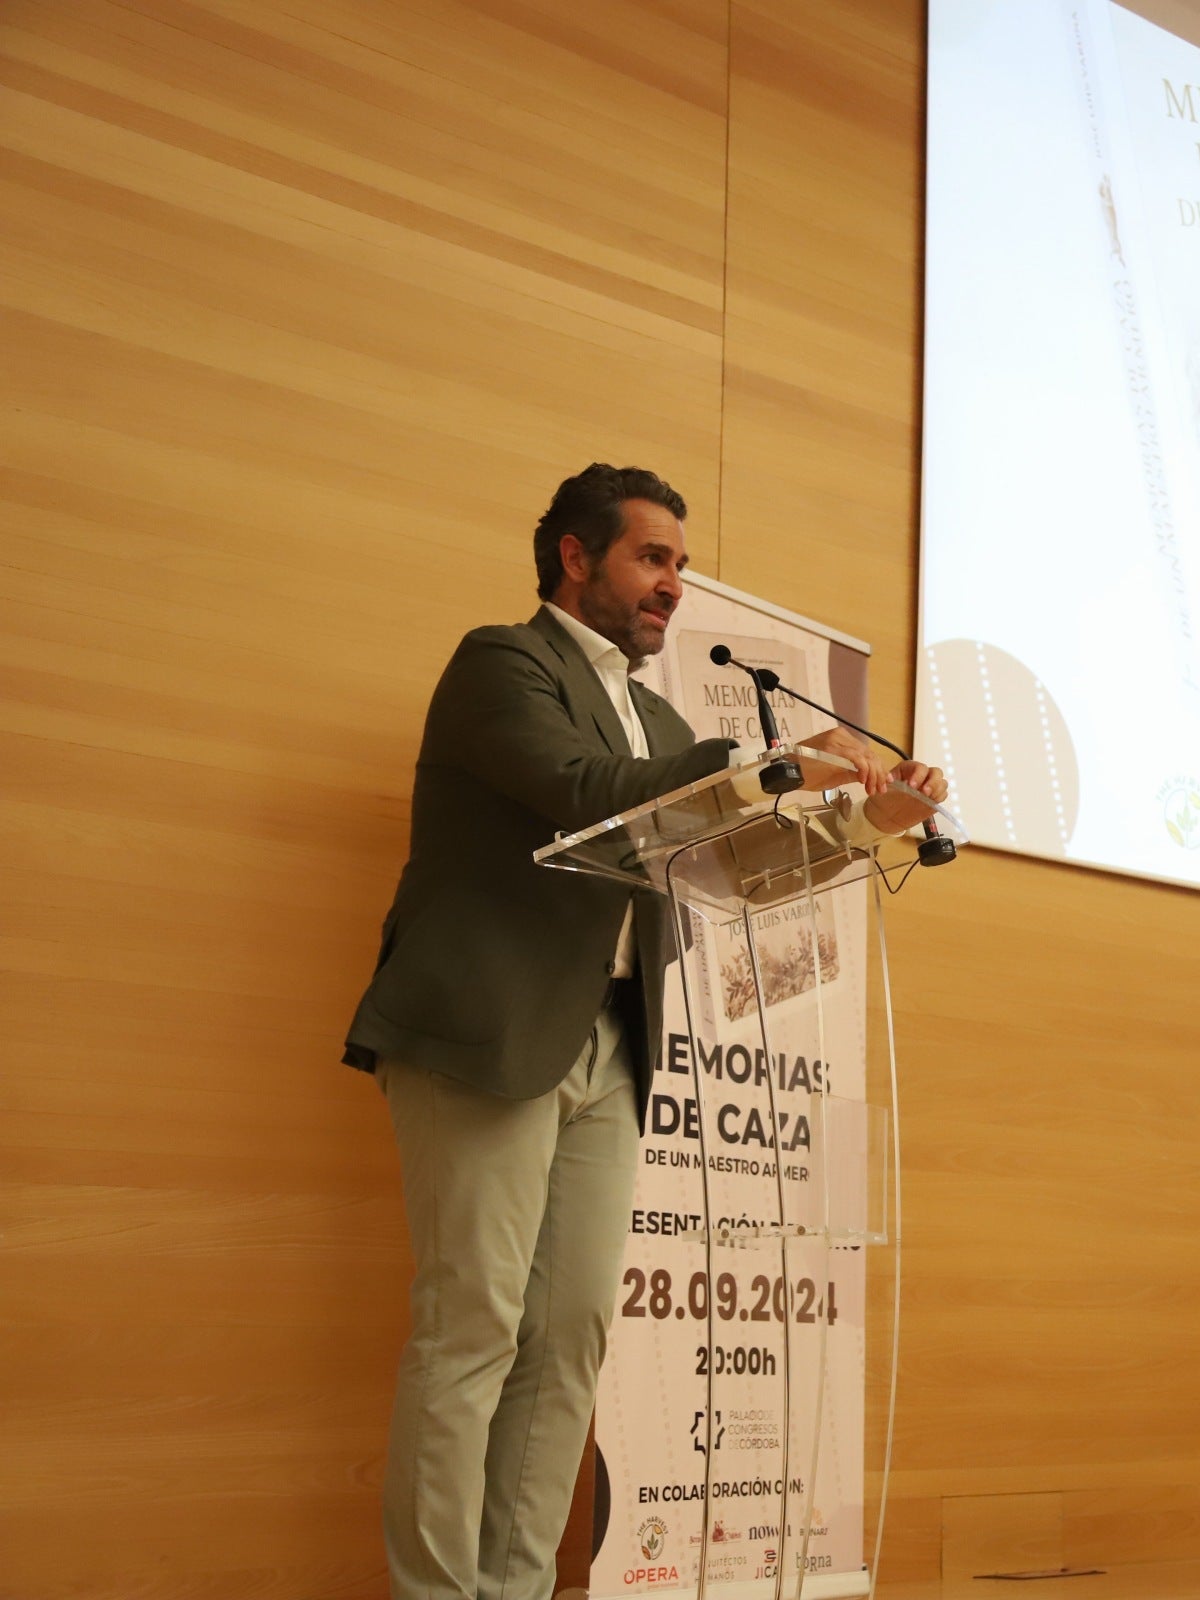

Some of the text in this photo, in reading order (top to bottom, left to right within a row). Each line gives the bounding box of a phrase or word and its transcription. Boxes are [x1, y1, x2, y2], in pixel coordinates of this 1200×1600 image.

[704, 684, 796, 708] MEMOIAS
[719, 717, 791, 739] DE CA
[757, 911, 780, 930] LUIS
[655, 1033, 831, 1096] EMORIAS
[652, 1094, 704, 1139] DE
[645, 1149, 667, 1165] DE
[670, 1151, 690, 1168] UN
[621, 1268, 838, 1325] 28.09.2024
[696, 1346, 776, 1375] 20:00h
[639, 1486, 659, 1503] EN
[774, 1478, 804, 1495] CN:
[624, 1565, 679, 1585] OPERA
[755, 1566, 779, 1580] JICA
